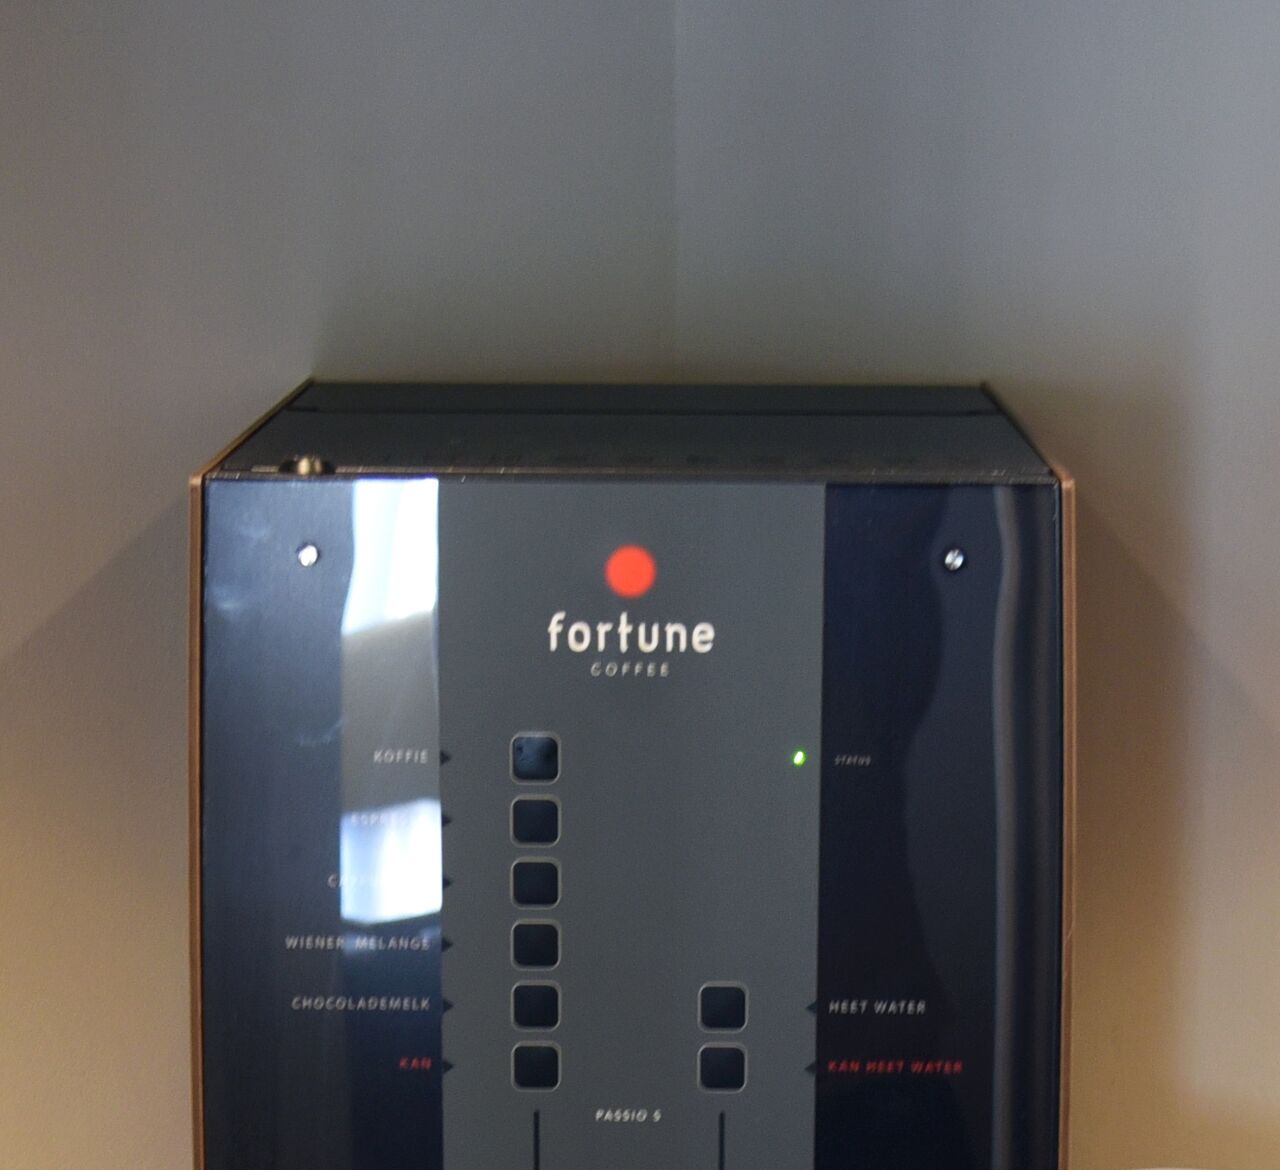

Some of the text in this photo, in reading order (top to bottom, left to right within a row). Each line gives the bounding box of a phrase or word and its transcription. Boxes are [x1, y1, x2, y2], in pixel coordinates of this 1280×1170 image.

[547, 610, 715, 654] fortune
[589, 661, 670, 677] COFFEE
[373, 748, 430, 765] KOFFIE
[284, 935, 432, 951] WIENER MELANGE
[290, 994, 432, 1012] CHOCOLADEMELK
[828, 999, 928, 1015] HEET WATER
[398, 1055, 433, 1071] KAN
[909, 1059, 964, 1074] WATER
[594, 1108, 648, 1123] PASSIO
